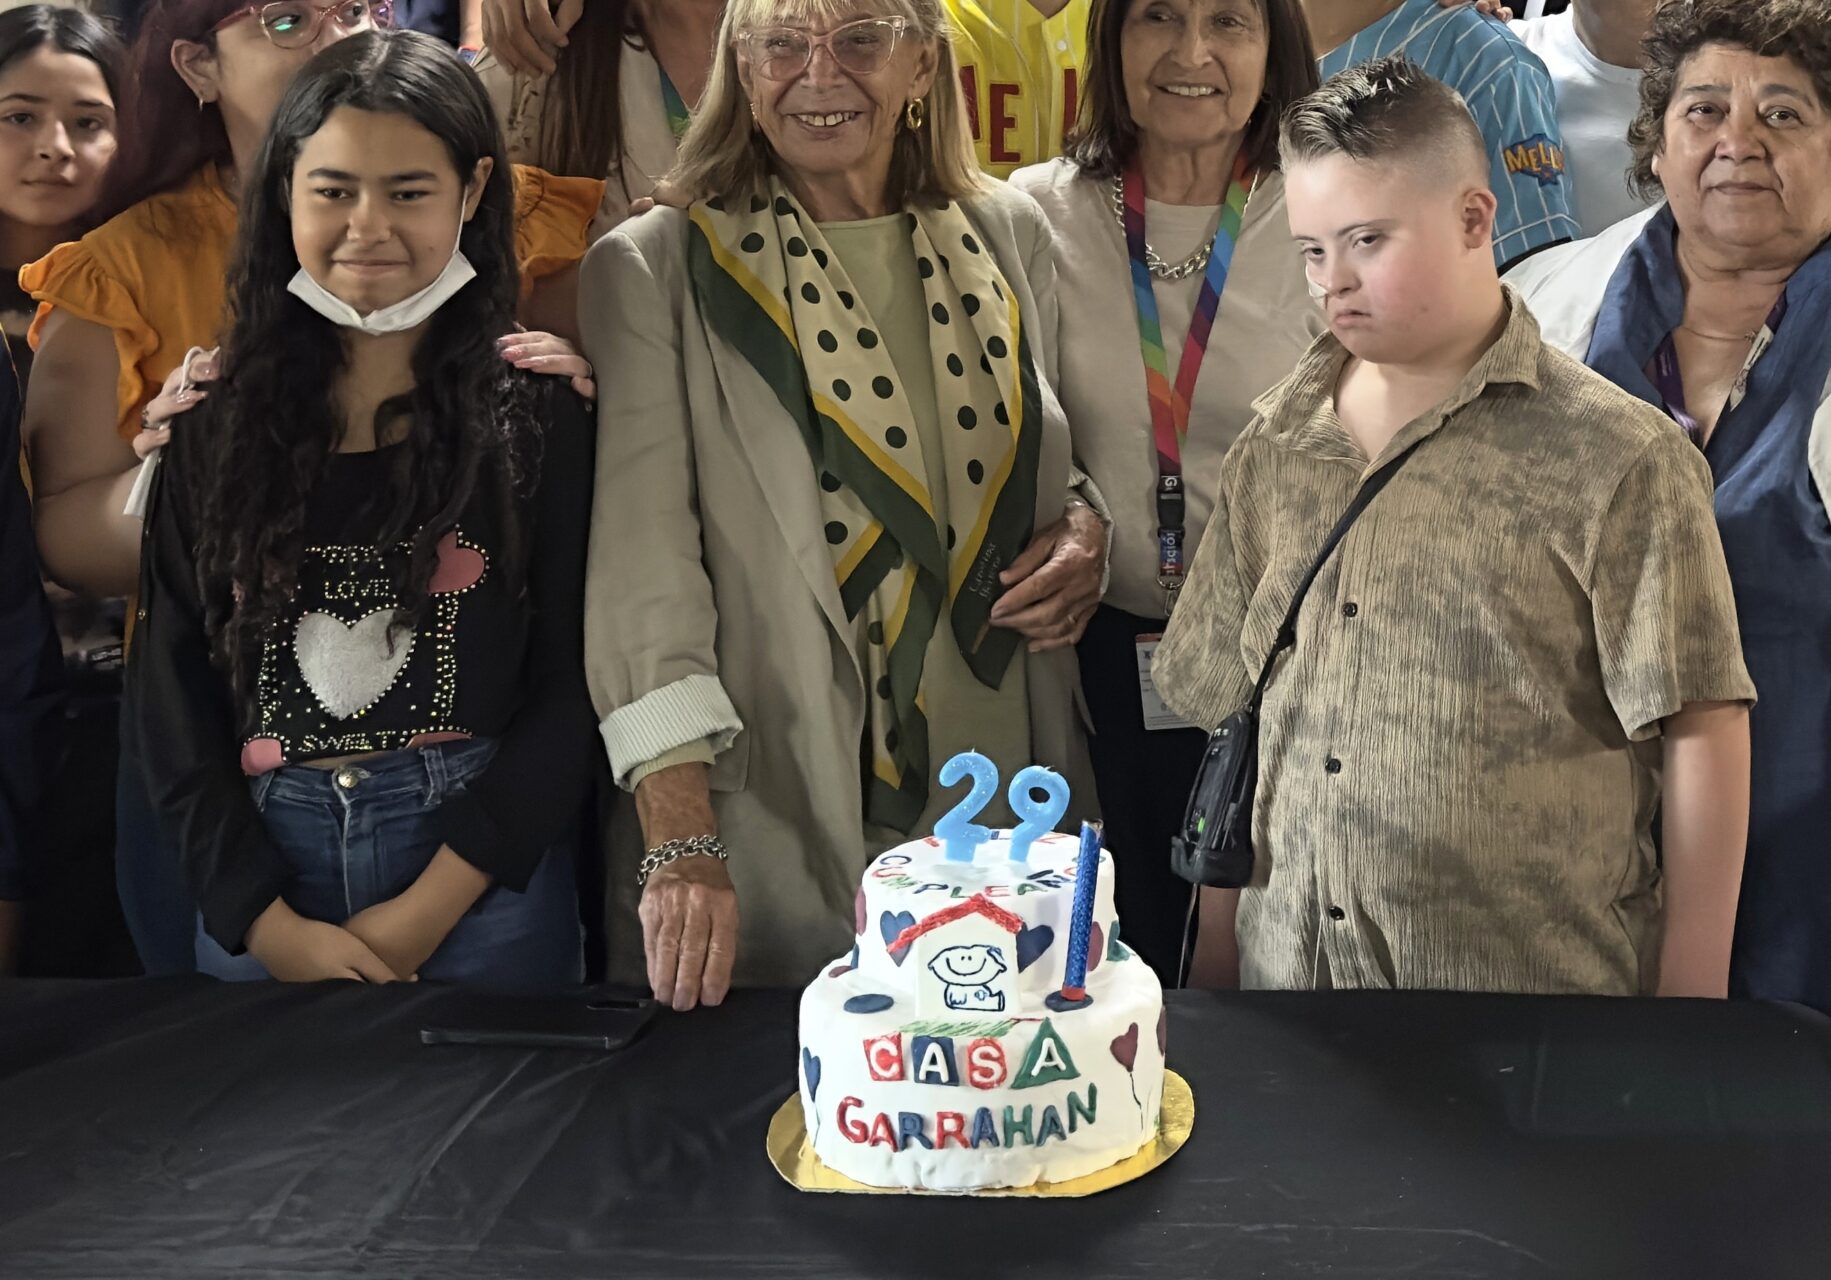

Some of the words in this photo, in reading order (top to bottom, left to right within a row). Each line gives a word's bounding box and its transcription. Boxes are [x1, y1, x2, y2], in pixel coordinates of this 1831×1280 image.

[934, 750, 1070, 864] 29
[866, 1032, 1072, 1087] CASA
[836, 1082, 1098, 1153] GARRAHAN
